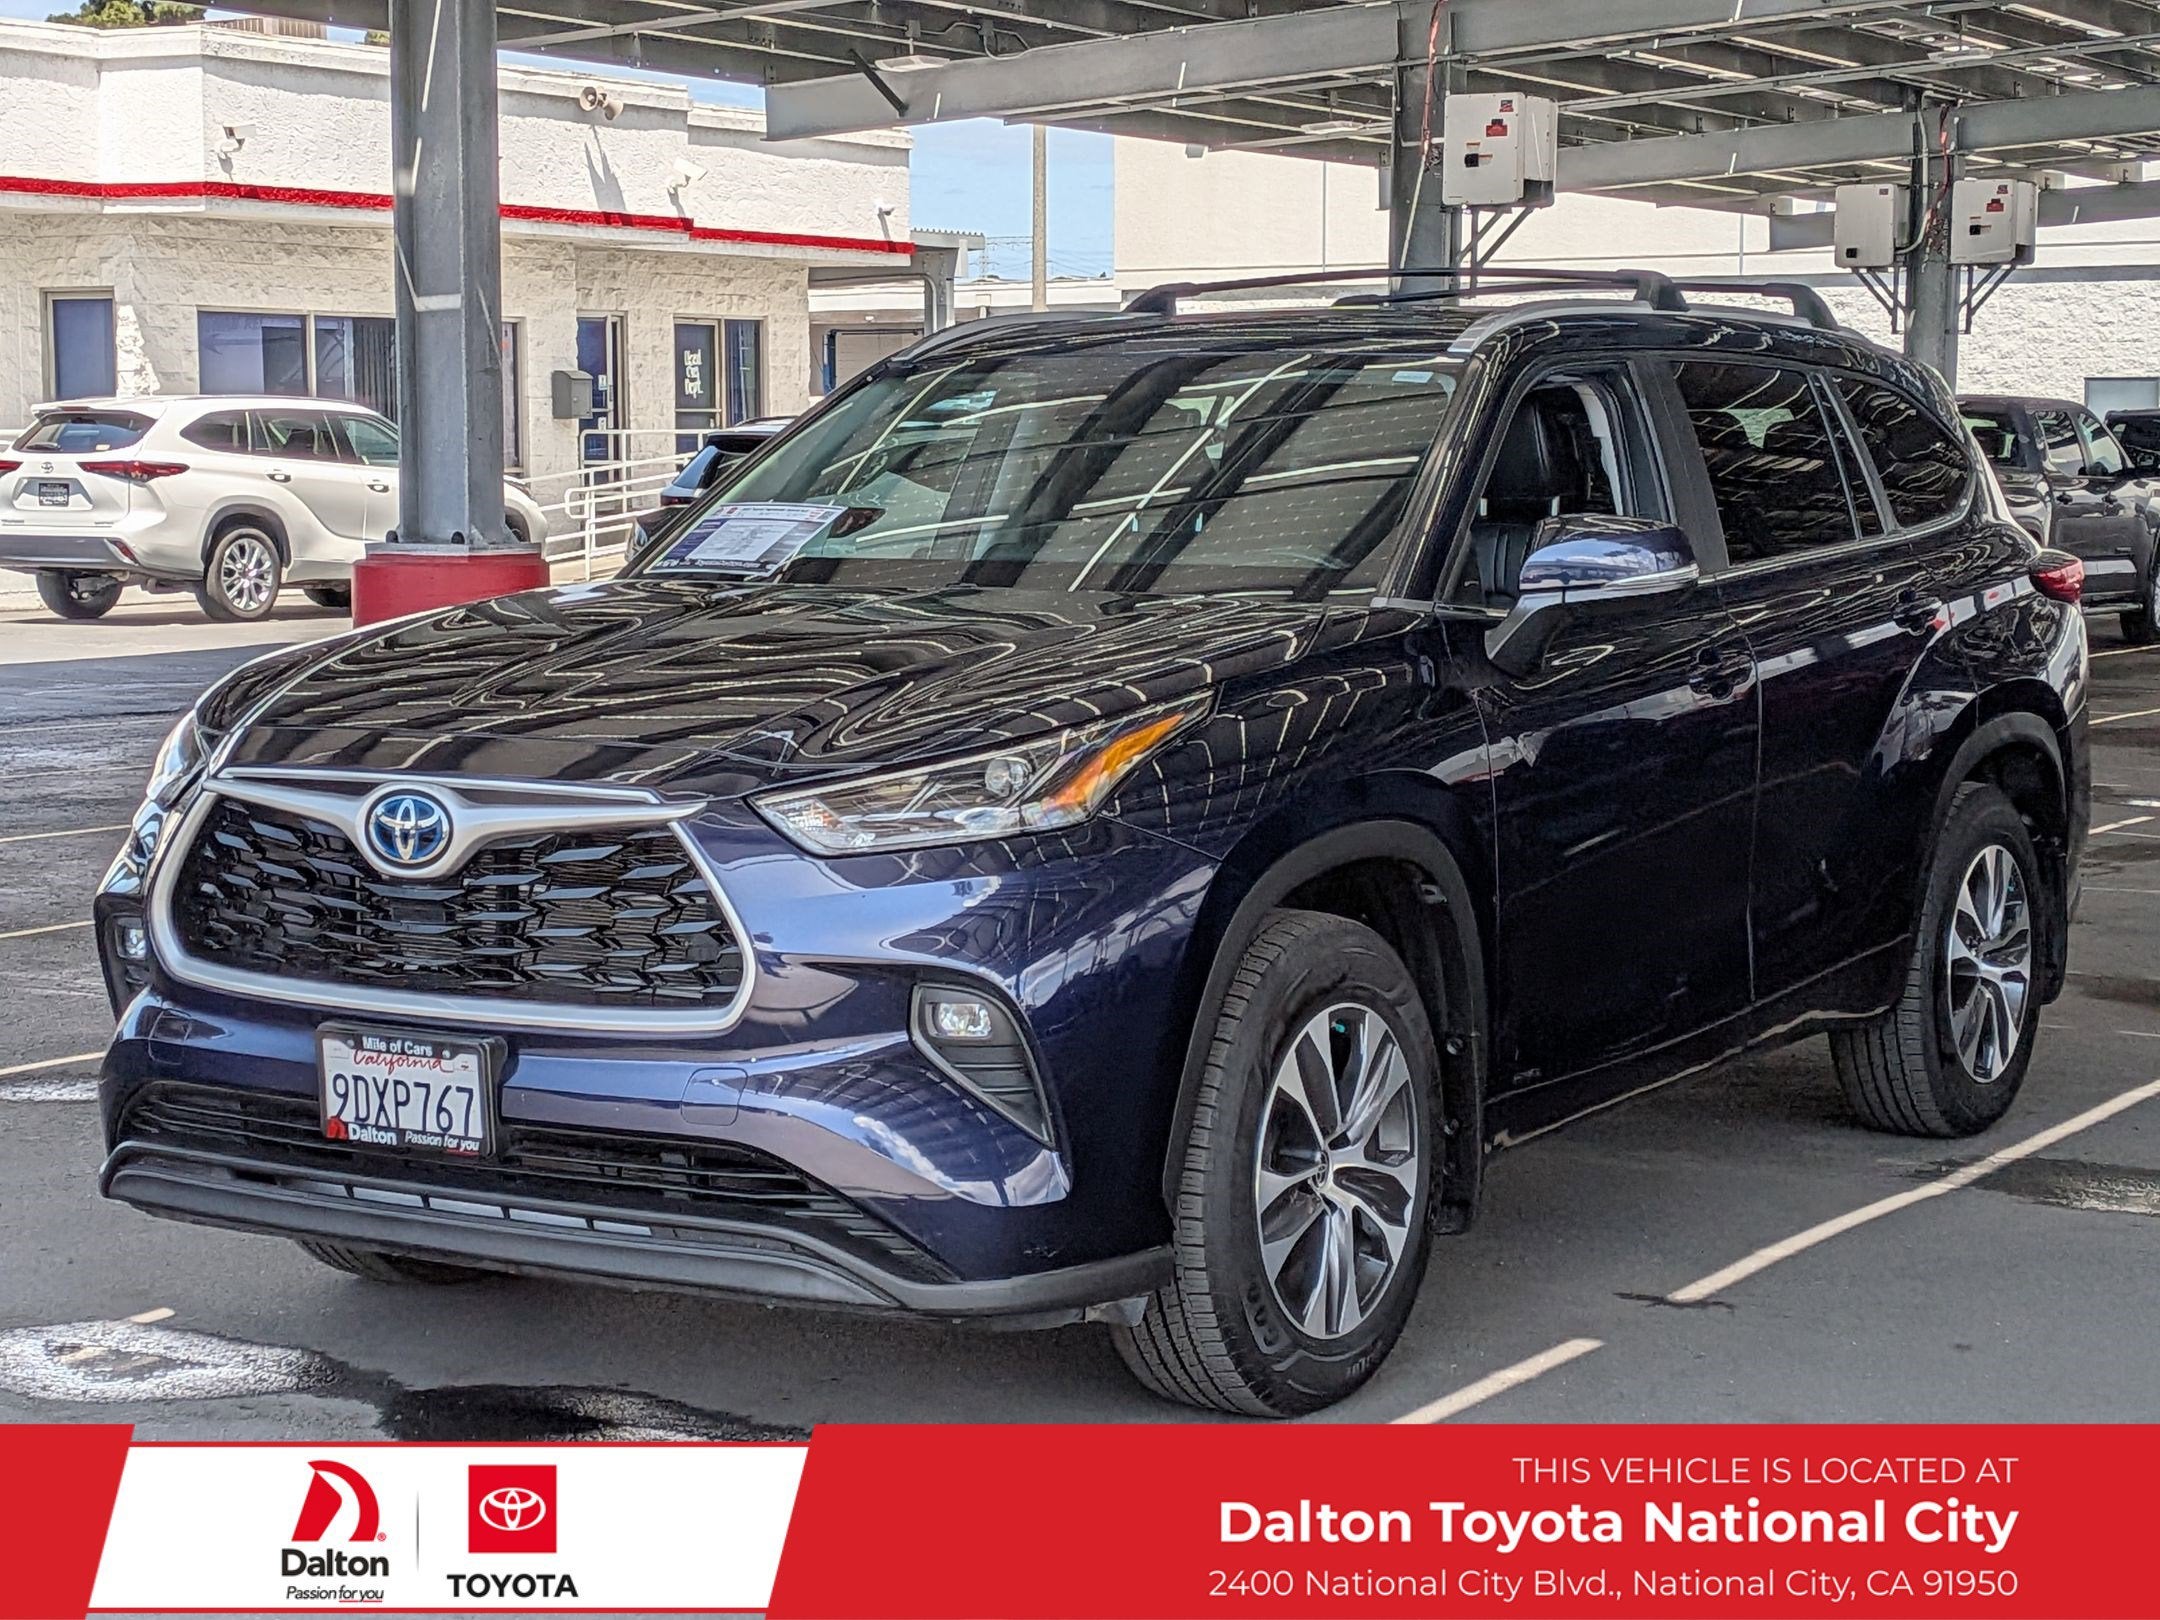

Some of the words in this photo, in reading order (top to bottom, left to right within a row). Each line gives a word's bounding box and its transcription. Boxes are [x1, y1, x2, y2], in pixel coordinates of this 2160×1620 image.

[362, 1036, 386, 1052] Mile
[389, 1039, 403, 1051] of
[404, 1040, 433, 1057] Cars
[353, 1050, 454, 1076] California
[332, 1073, 475, 1138] 9DXP767
[348, 1123, 397, 1146] Dalton
[405, 1130, 442, 1147] Passion
[442, 1133, 458, 1149] for
[459, 1138, 480, 1151] you
